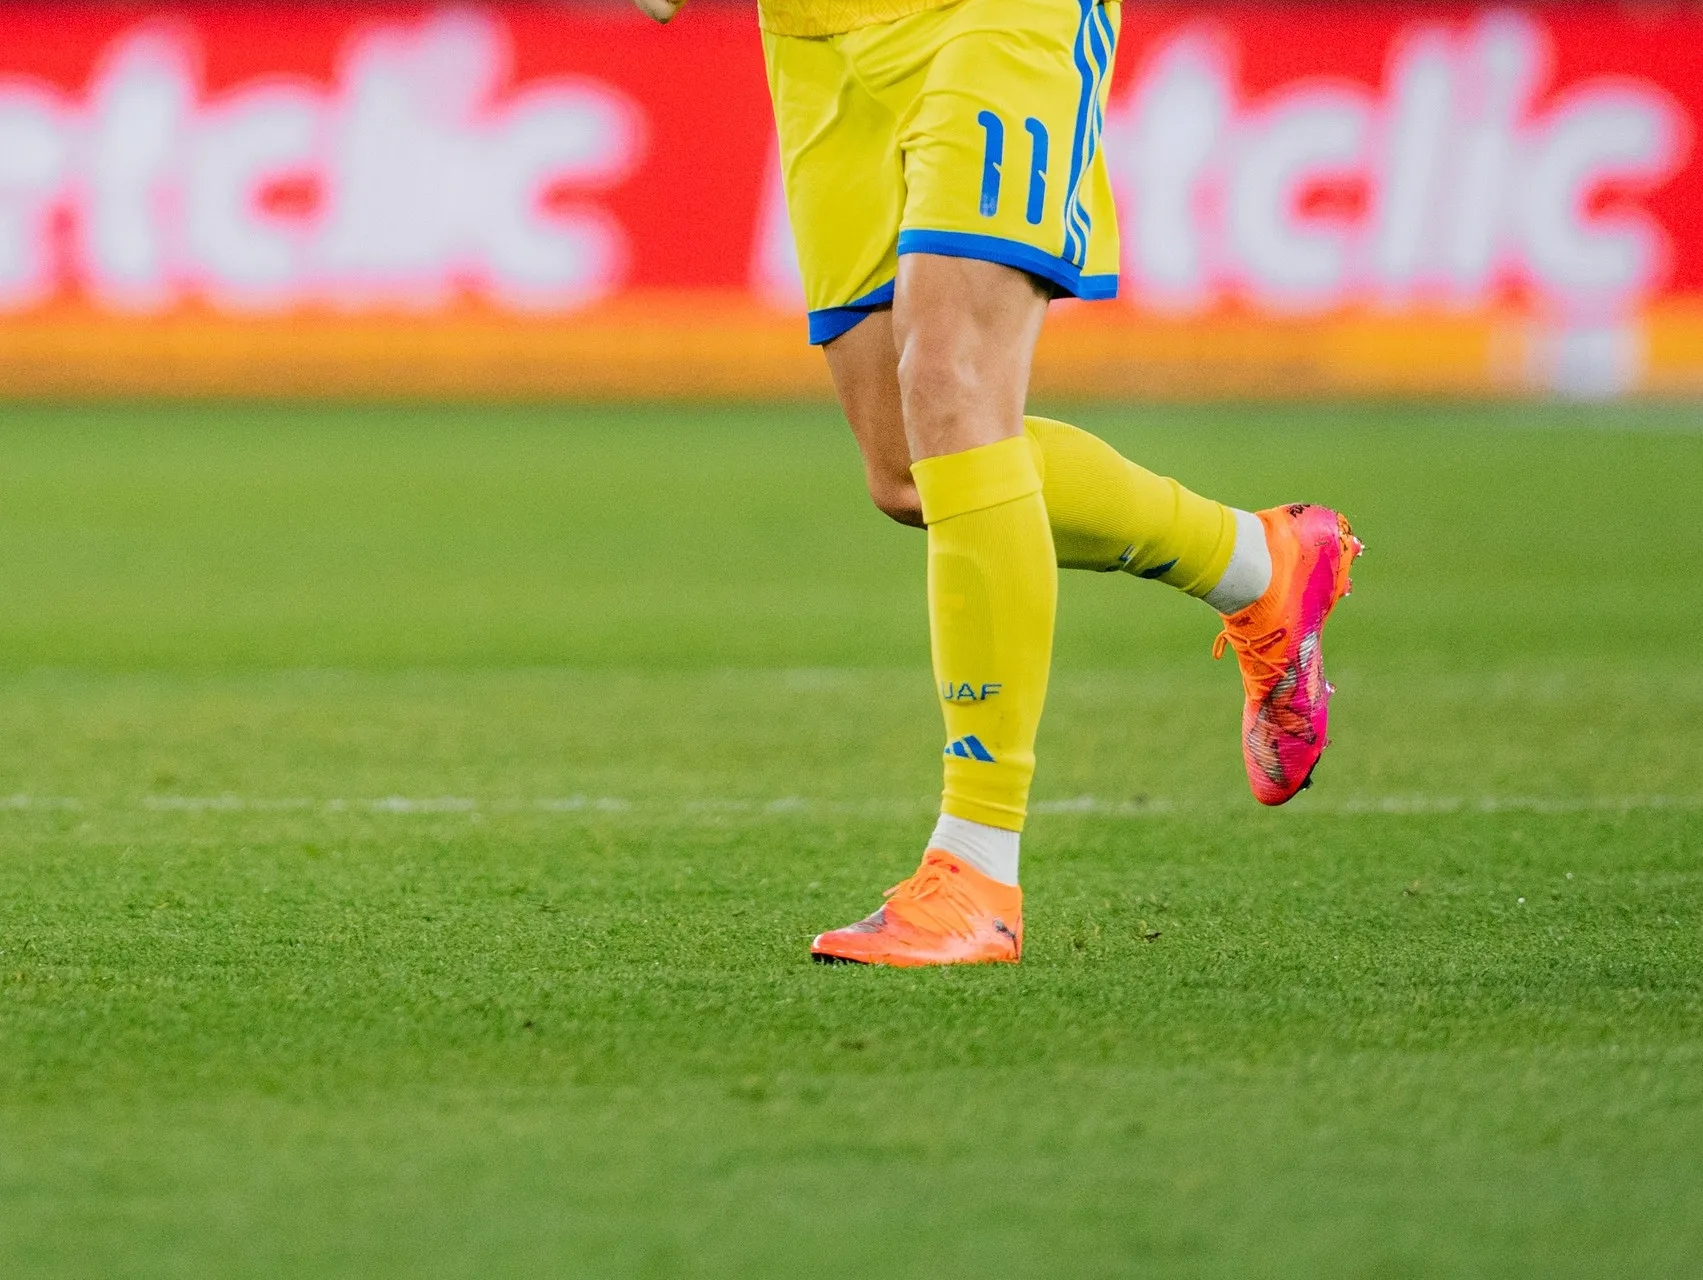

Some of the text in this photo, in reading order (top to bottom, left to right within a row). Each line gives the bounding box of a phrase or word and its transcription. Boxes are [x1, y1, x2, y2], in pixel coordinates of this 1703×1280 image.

[756, 15, 1682, 306] tclic
[977, 110, 1049, 225] 11
[942, 681, 1002, 700] UAF
